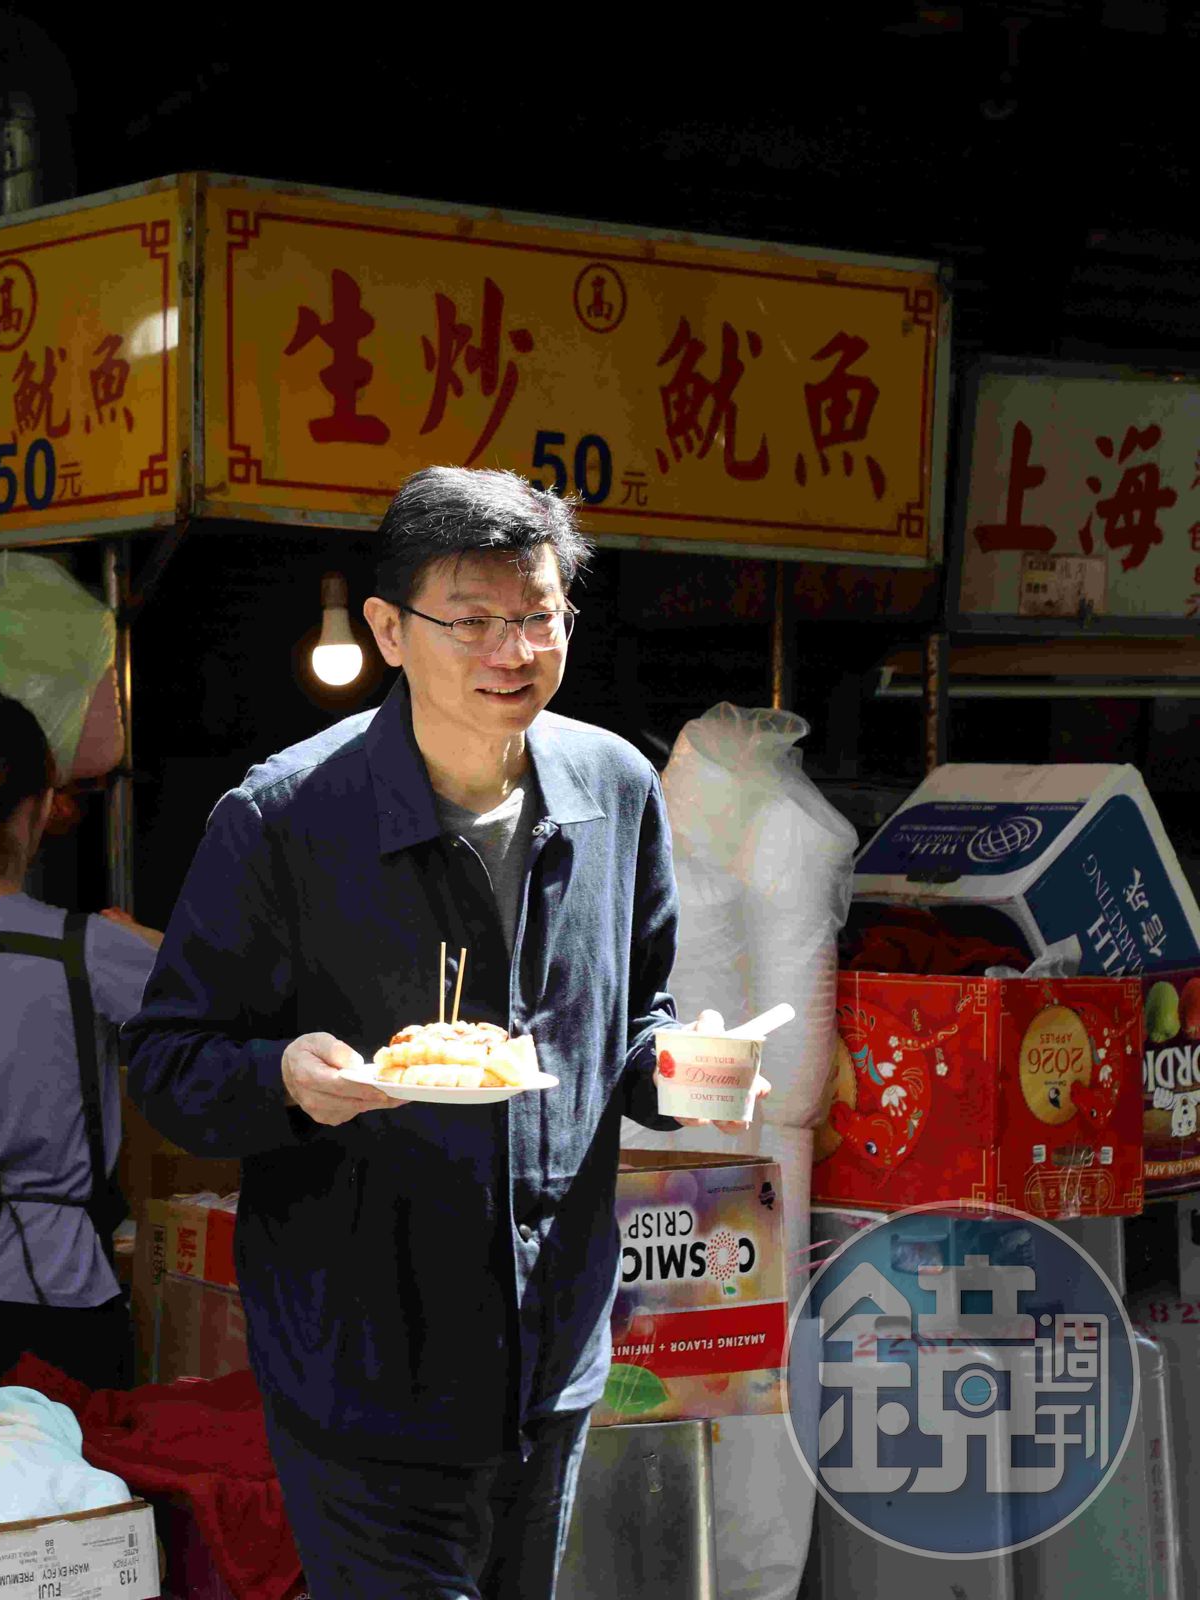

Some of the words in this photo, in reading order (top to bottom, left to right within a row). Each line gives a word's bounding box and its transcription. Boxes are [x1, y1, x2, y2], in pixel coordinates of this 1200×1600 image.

[973, 420, 1178, 574] 上海
[1027, 1047, 1084, 1077] 2026
[627, 1209, 694, 1239] CRISP
[622, 1231, 756, 1283] COSMIC
[670, 1339, 713, 1352] FLAVOR
[718, 1333, 766, 1349] AMAZING
[0, 1571, 35, 1586] PREMIUM
[119, 1568, 138, 1585] 113
[38, 1582, 62, 1600] FUJI
